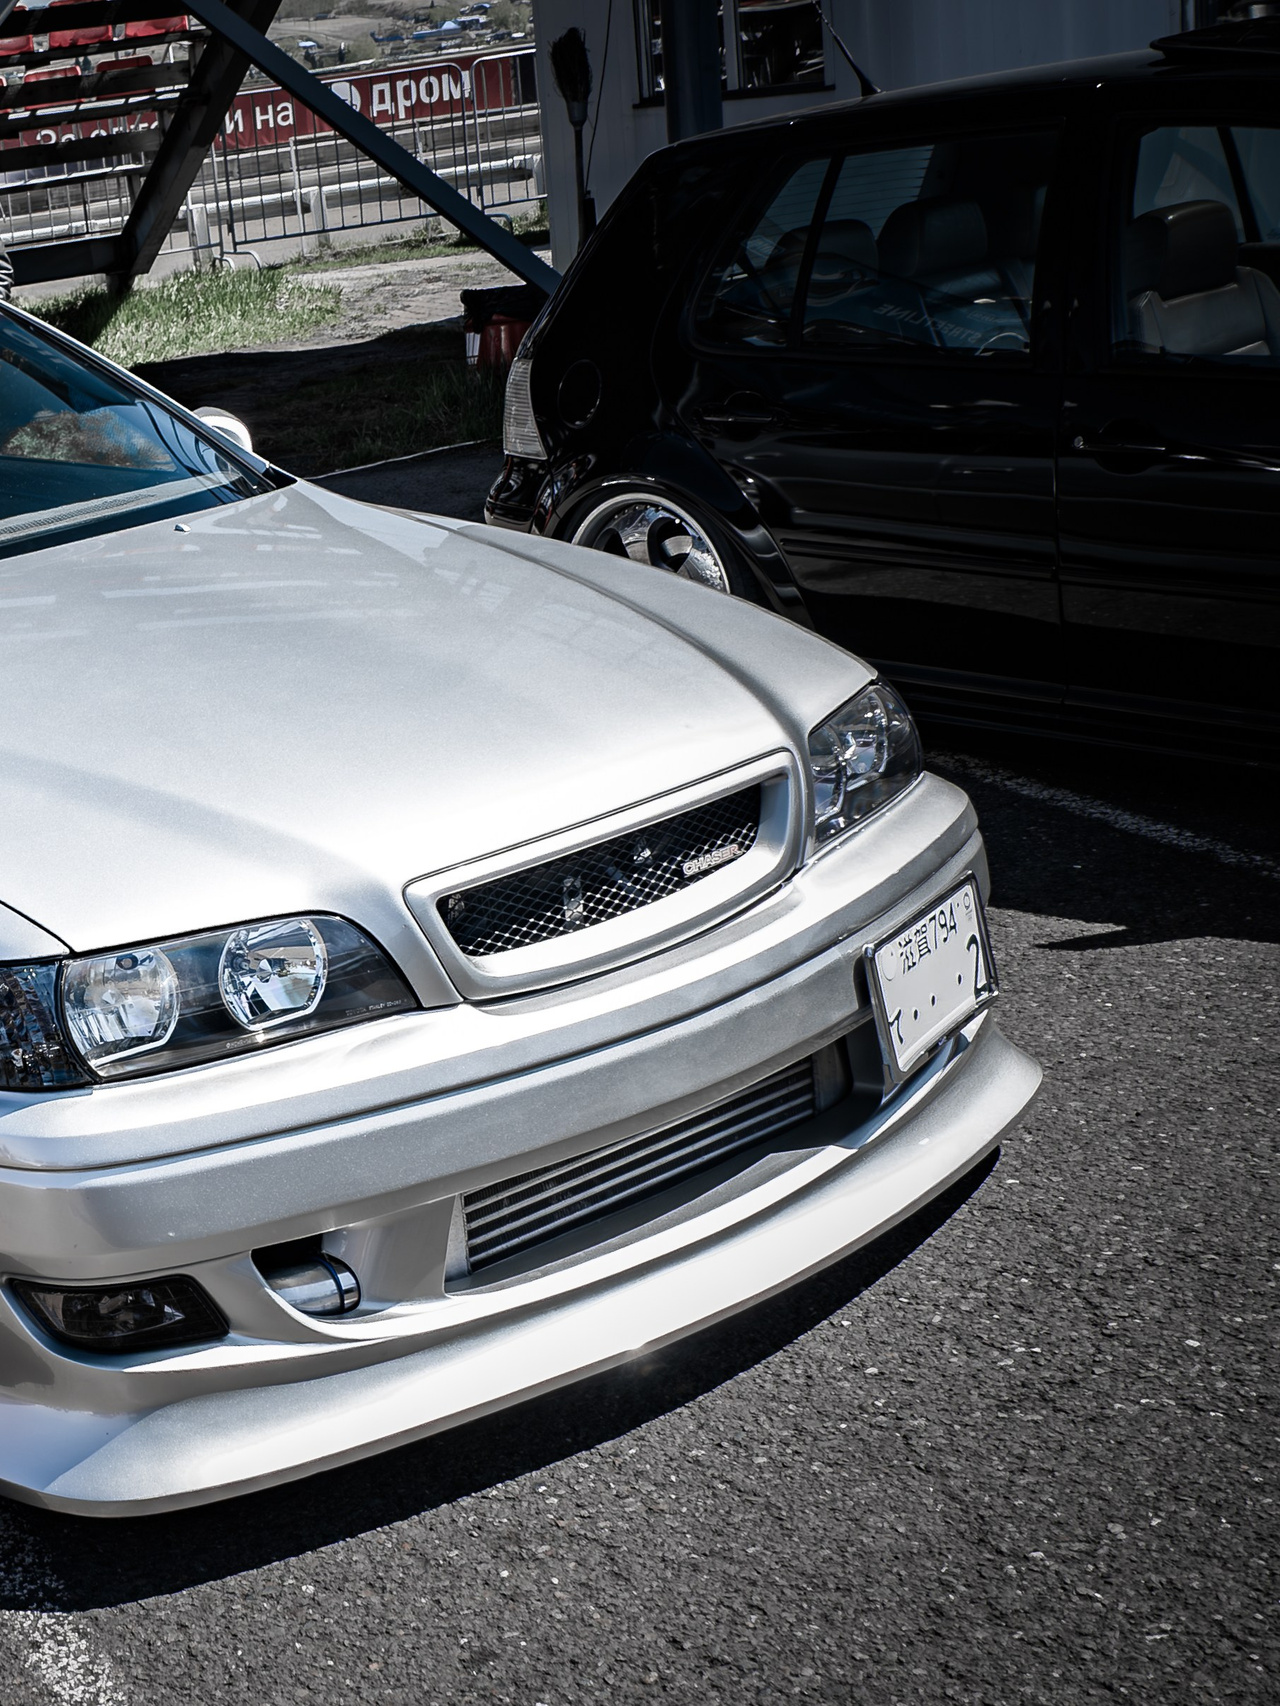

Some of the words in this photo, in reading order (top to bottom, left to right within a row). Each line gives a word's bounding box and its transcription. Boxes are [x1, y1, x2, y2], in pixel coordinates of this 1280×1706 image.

[255, 102, 294, 130] на
[370, 70, 472, 119] дром
[682, 844, 743, 876] CHASER
